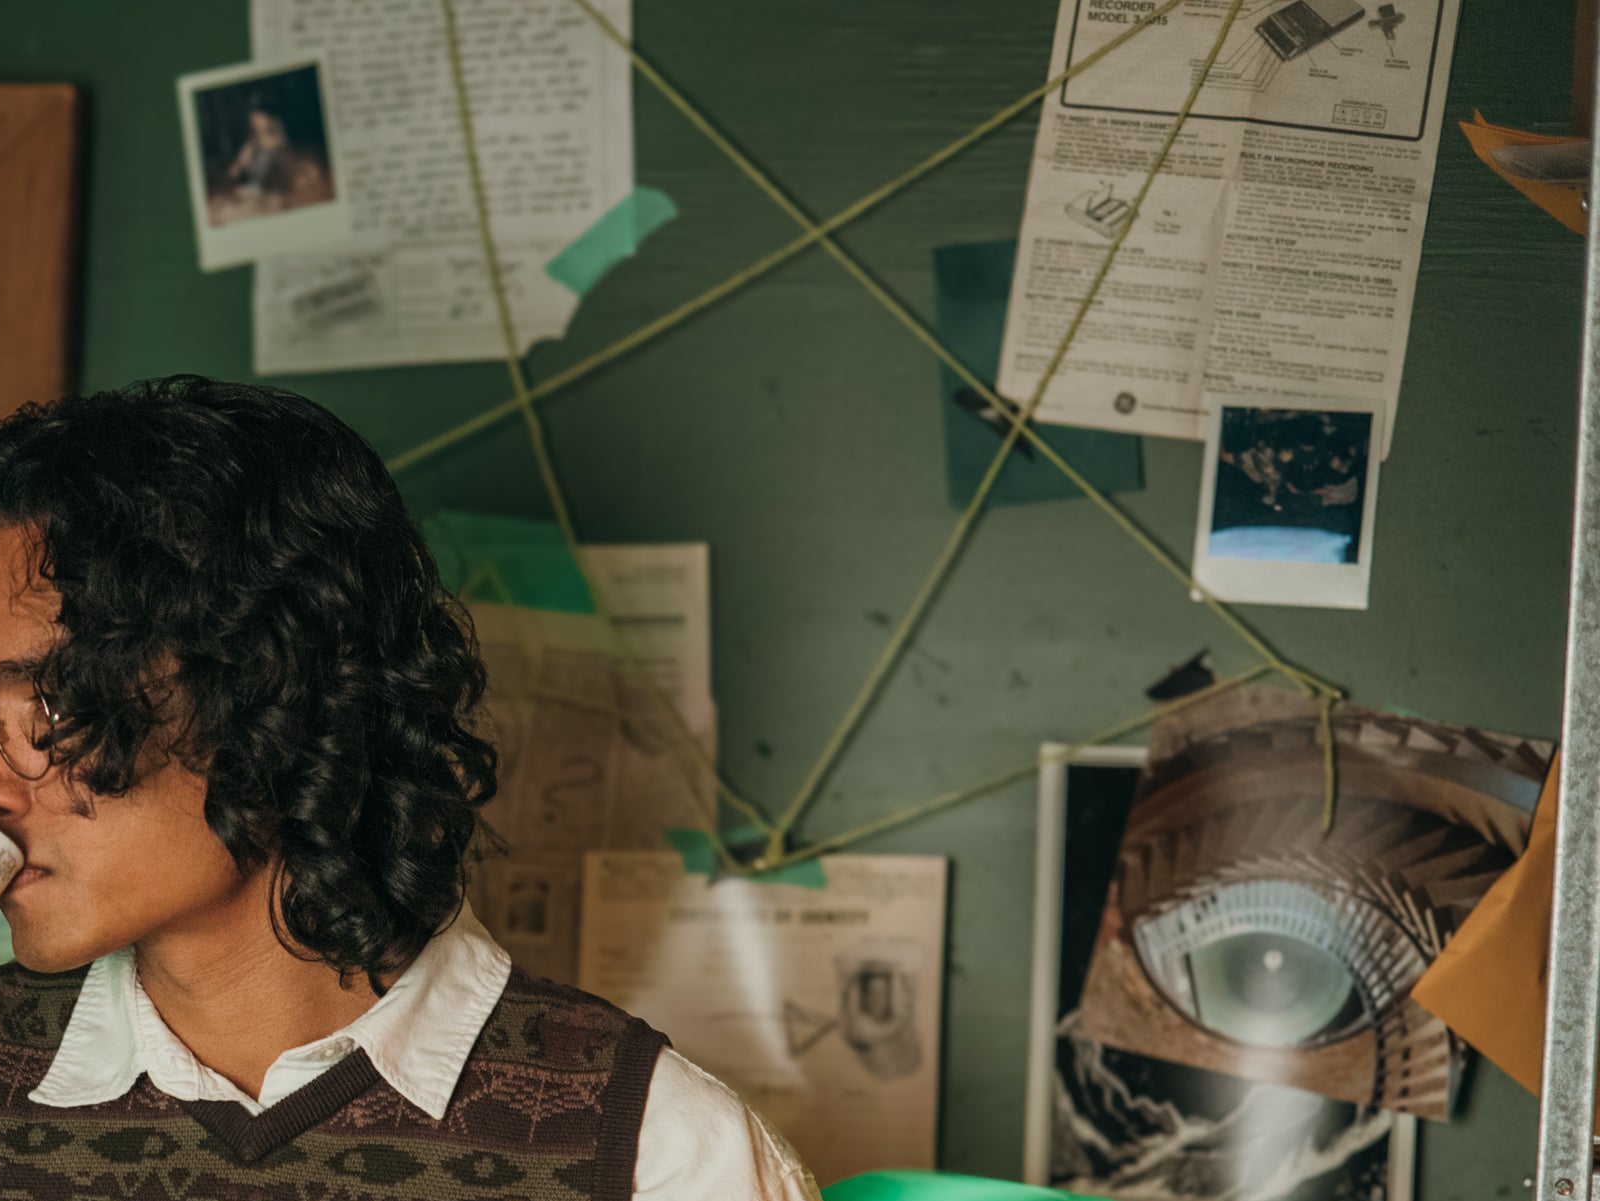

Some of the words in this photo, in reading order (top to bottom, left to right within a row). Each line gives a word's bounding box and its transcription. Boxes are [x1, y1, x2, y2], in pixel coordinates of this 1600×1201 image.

[1088, 11, 1129, 24] MODEL
[1274, 155, 1326, 168] MICROPHONE
[1327, 161, 1374, 173] RECORDING
